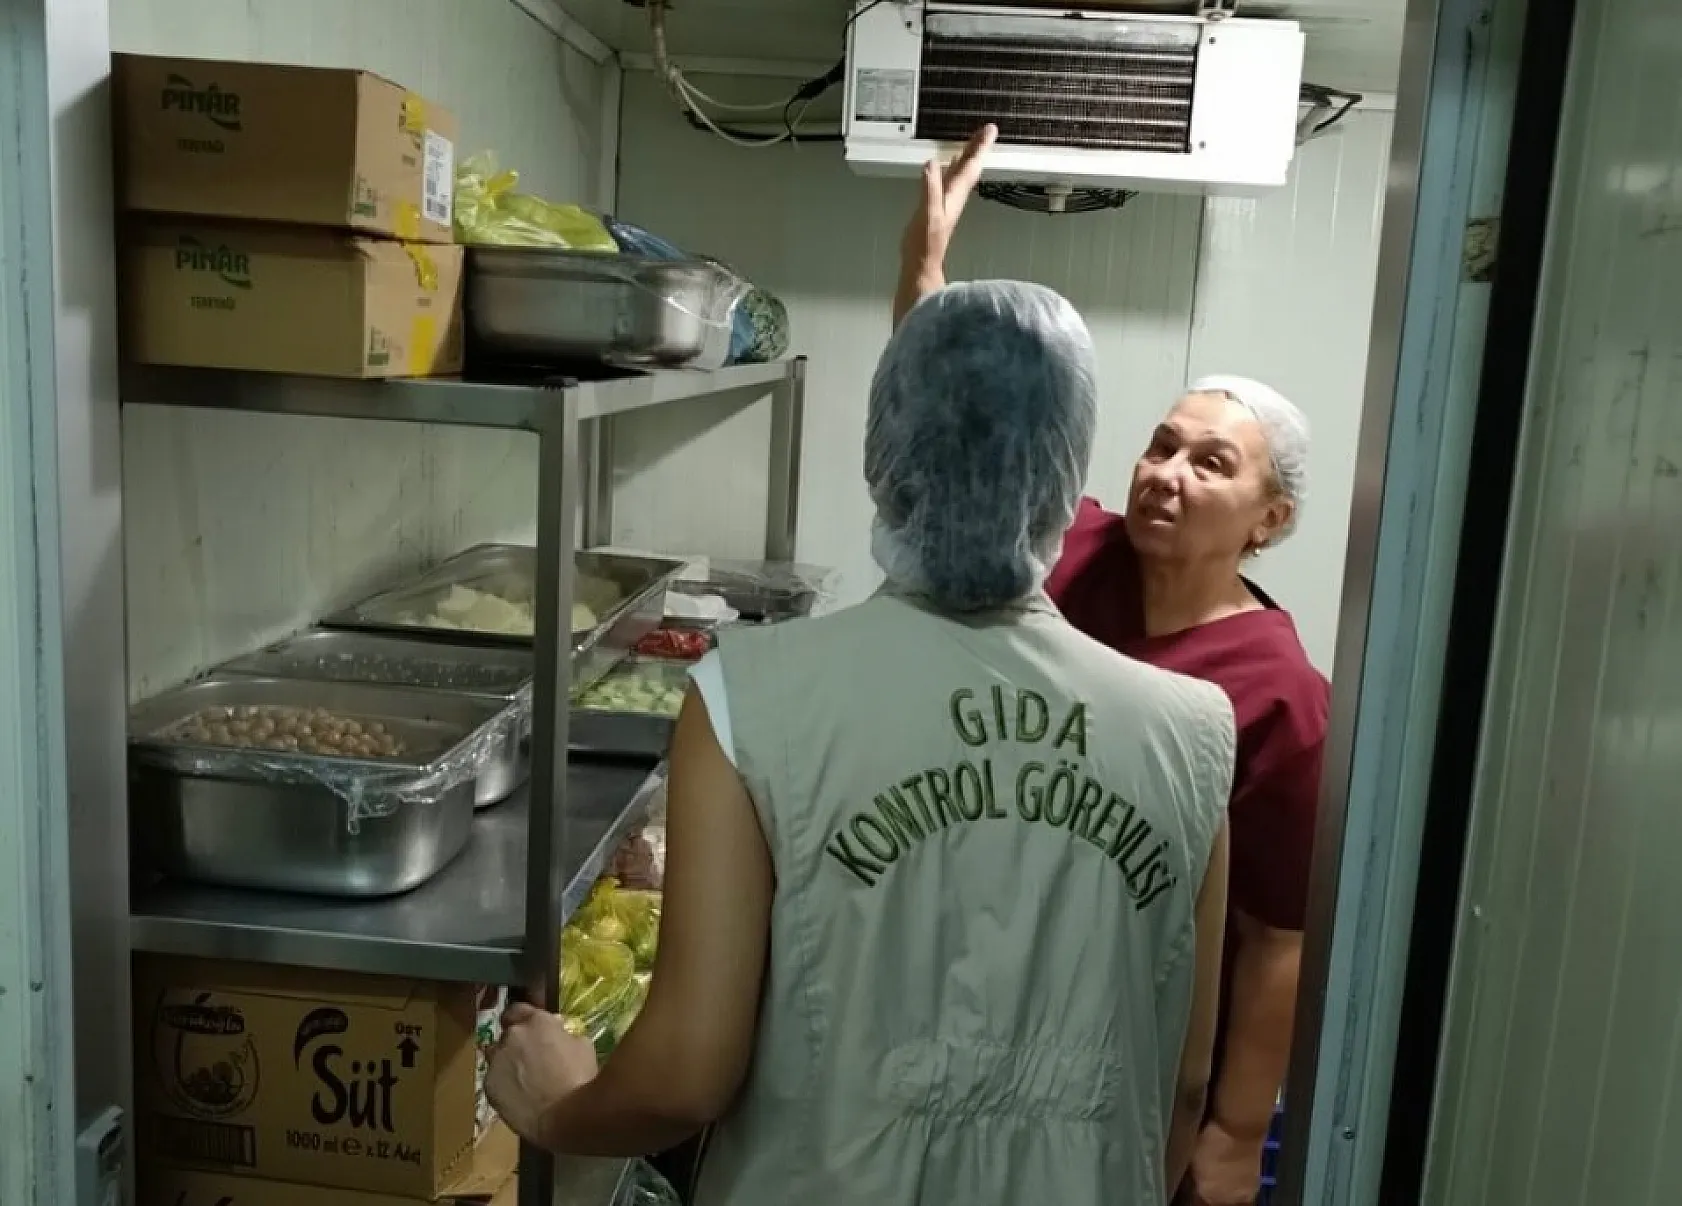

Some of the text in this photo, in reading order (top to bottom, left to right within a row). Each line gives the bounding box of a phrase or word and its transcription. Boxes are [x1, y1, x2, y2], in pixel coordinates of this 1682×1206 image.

[950, 685, 1087, 757] GIDA
[825, 758, 1177, 912] KONTROL GÖREVLİSİ
[312, 1045, 398, 1134] Süt
[286, 1129, 321, 1151] 1000
